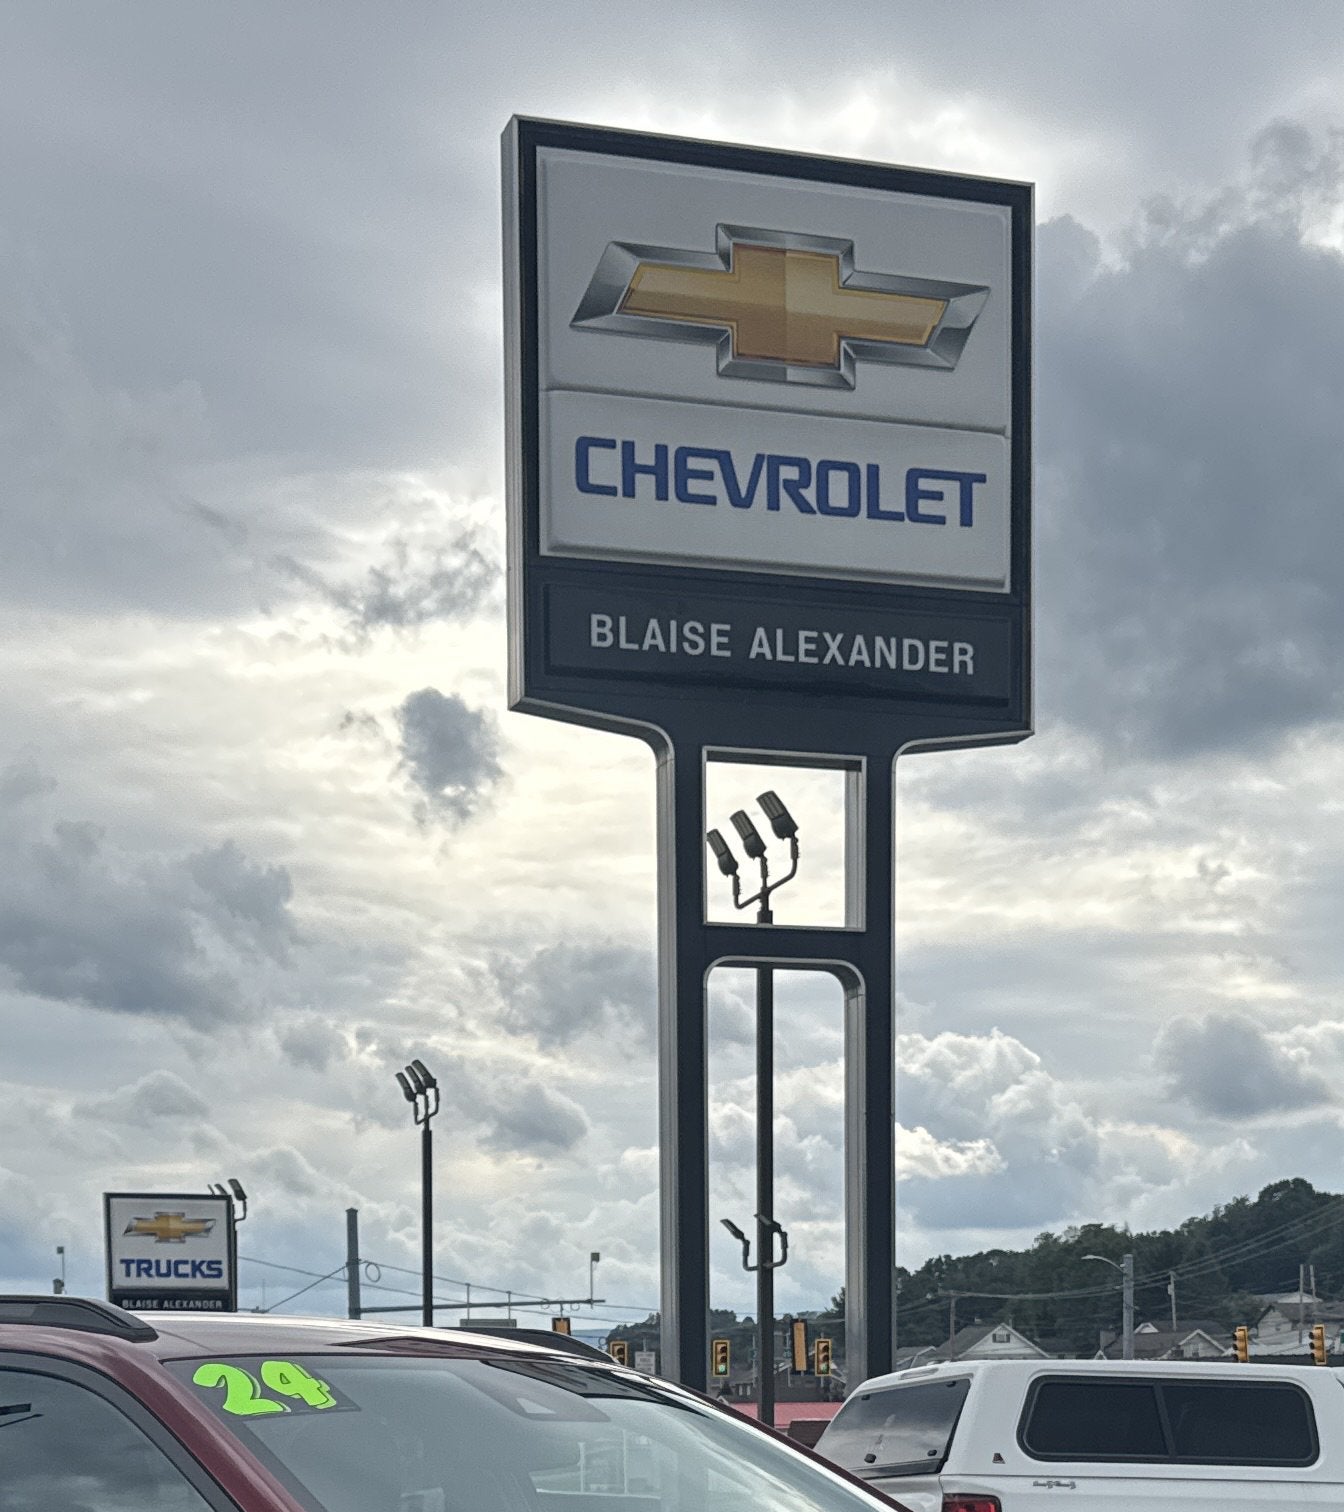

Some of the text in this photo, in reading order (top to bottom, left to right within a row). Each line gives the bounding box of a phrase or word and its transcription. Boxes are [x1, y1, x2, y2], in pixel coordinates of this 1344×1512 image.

[574, 435, 987, 528] CHEVROLET
[589, 612, 975, 676] BLAISE ALEXANDER
[119, 1258, 223, 1279] TRUCKS
[122, 1299, 223, 1310] BLAISE ALEXANDER
[192, 1360, 337, 1416] 24
